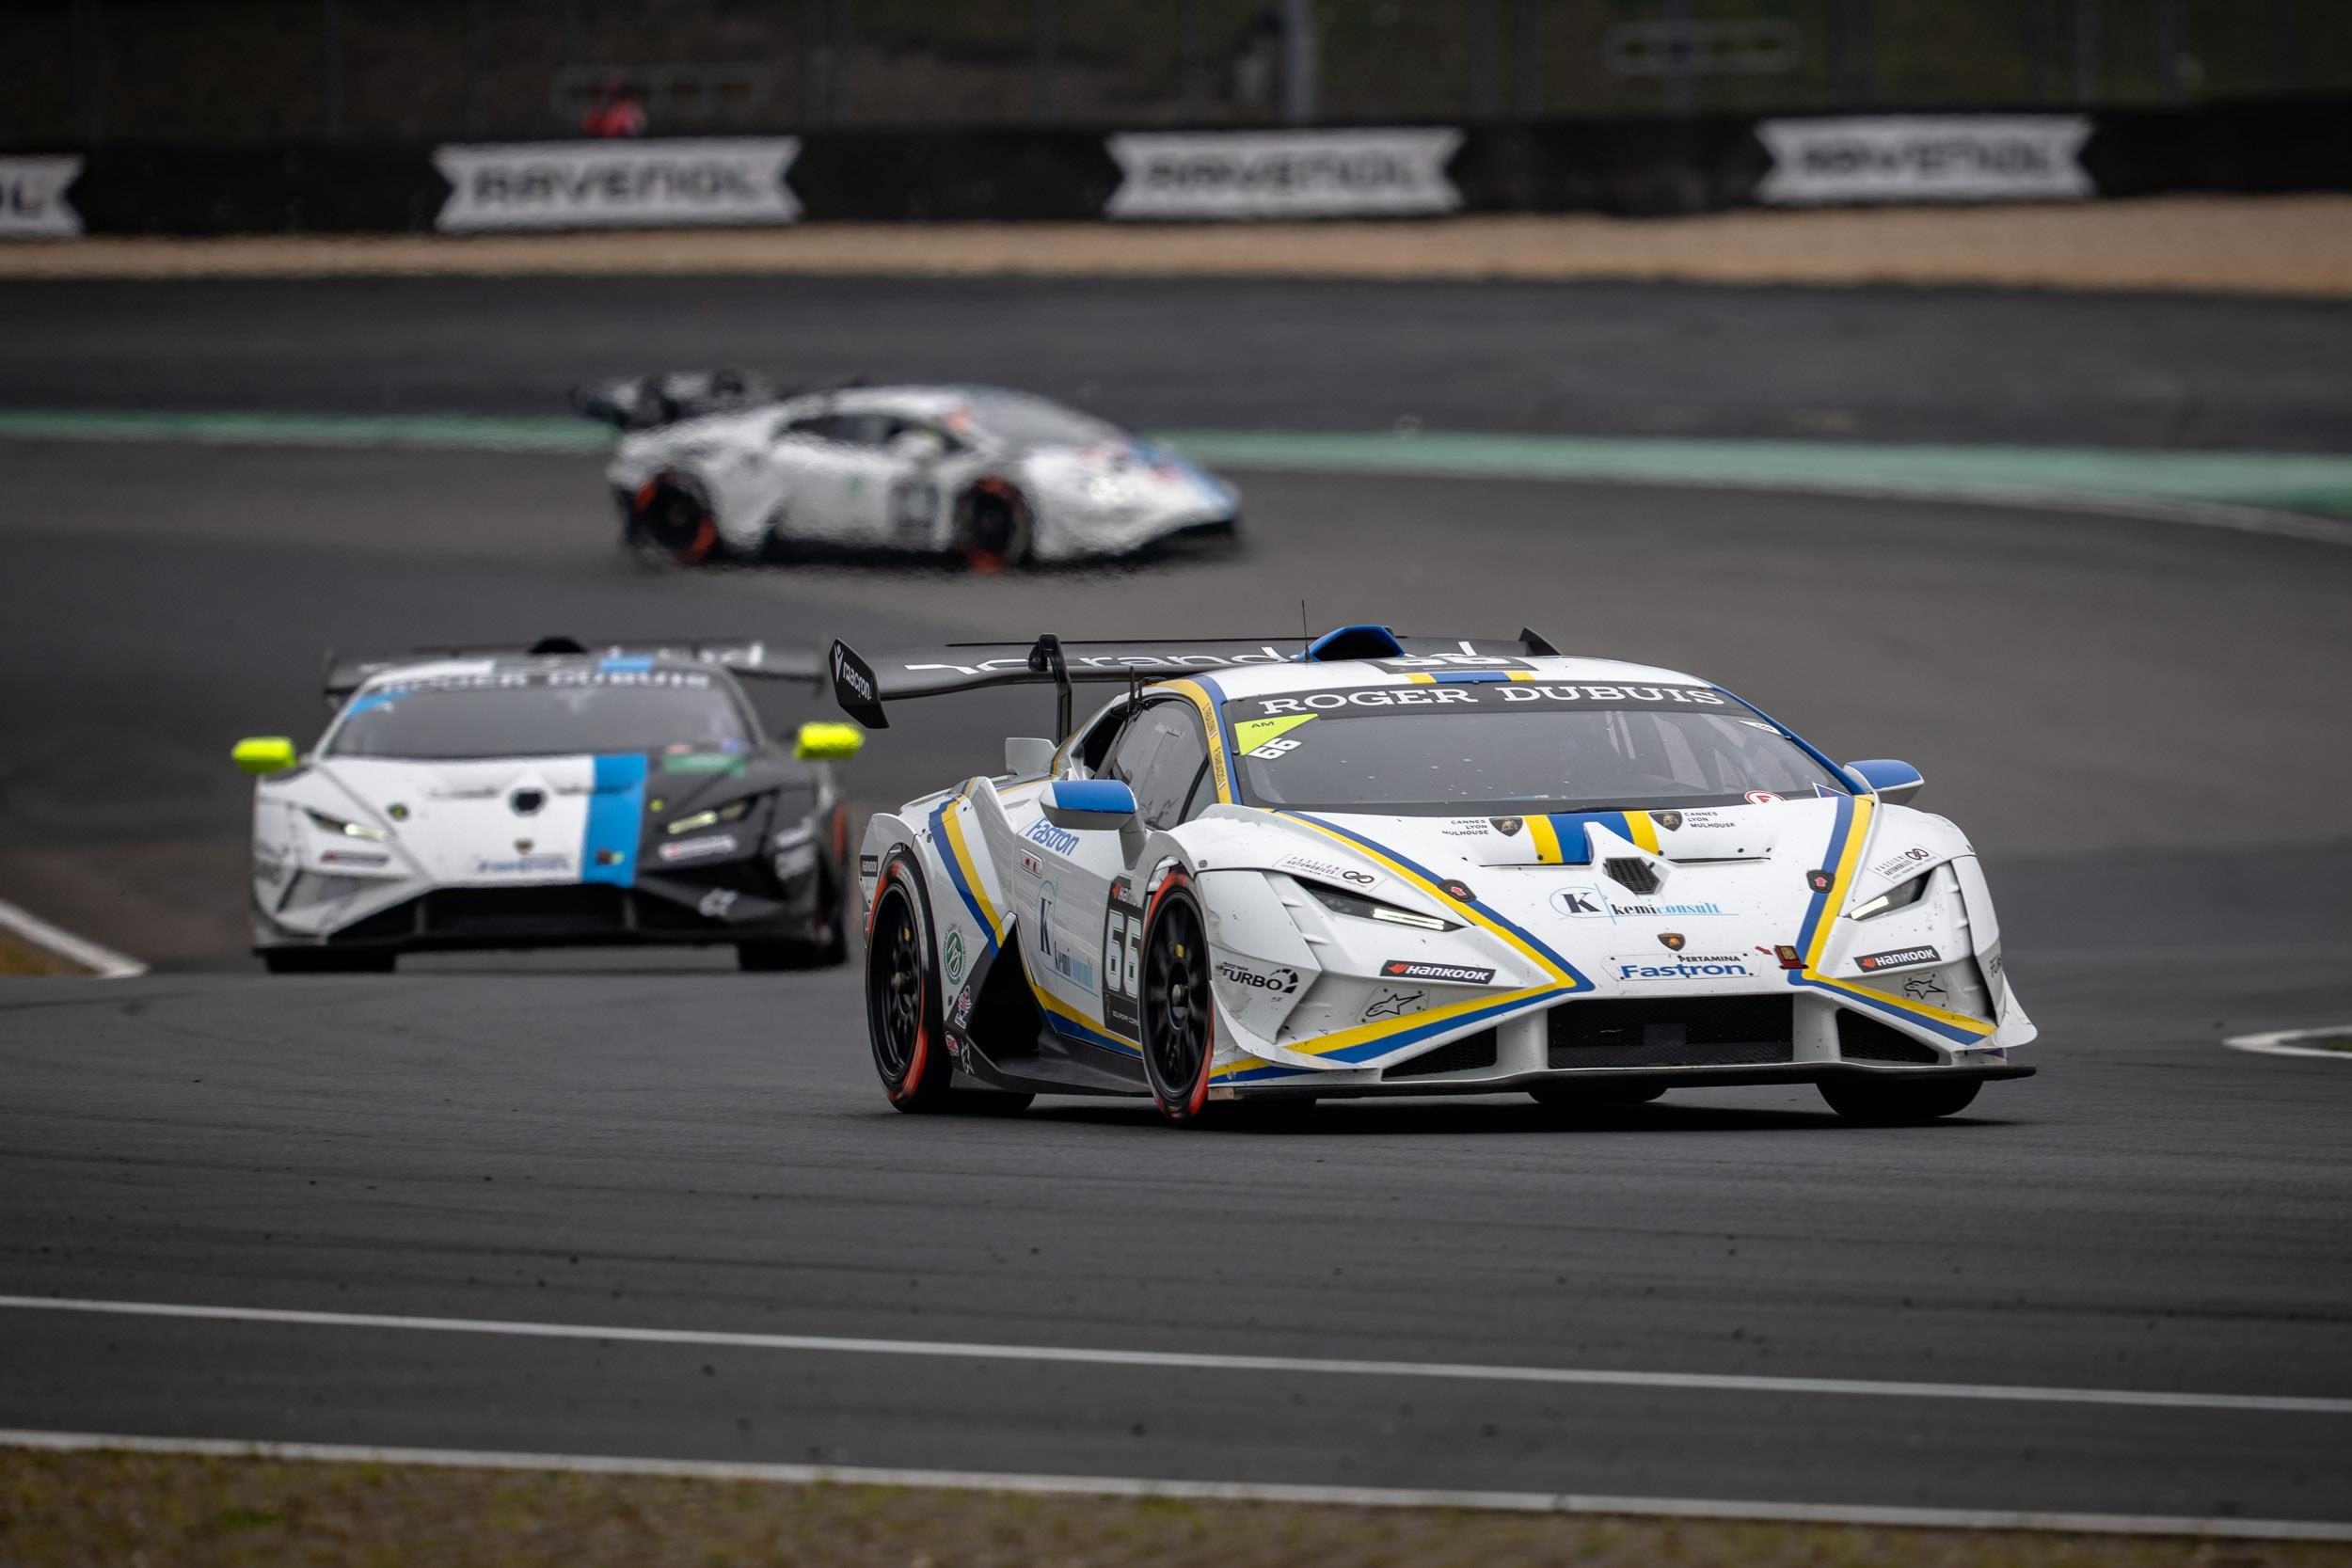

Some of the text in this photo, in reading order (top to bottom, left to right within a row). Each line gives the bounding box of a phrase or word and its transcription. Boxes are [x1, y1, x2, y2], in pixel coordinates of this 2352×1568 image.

[843, 661, 871, 701] macron
[1258, 686, 1724, 715] ROGER DUBUIS
[1251, 721, 1275, 729] AM
[1248, 736, 1302, 760] 66
[1562, 893, 1601, 913] K
[1611, 902, 1722, 915] kemiconsult
[1105, 909, 1141, 999] 66
[1223, 968, 1283, 990] TURBO
[1621, 963, 1746, 979] Fastron
